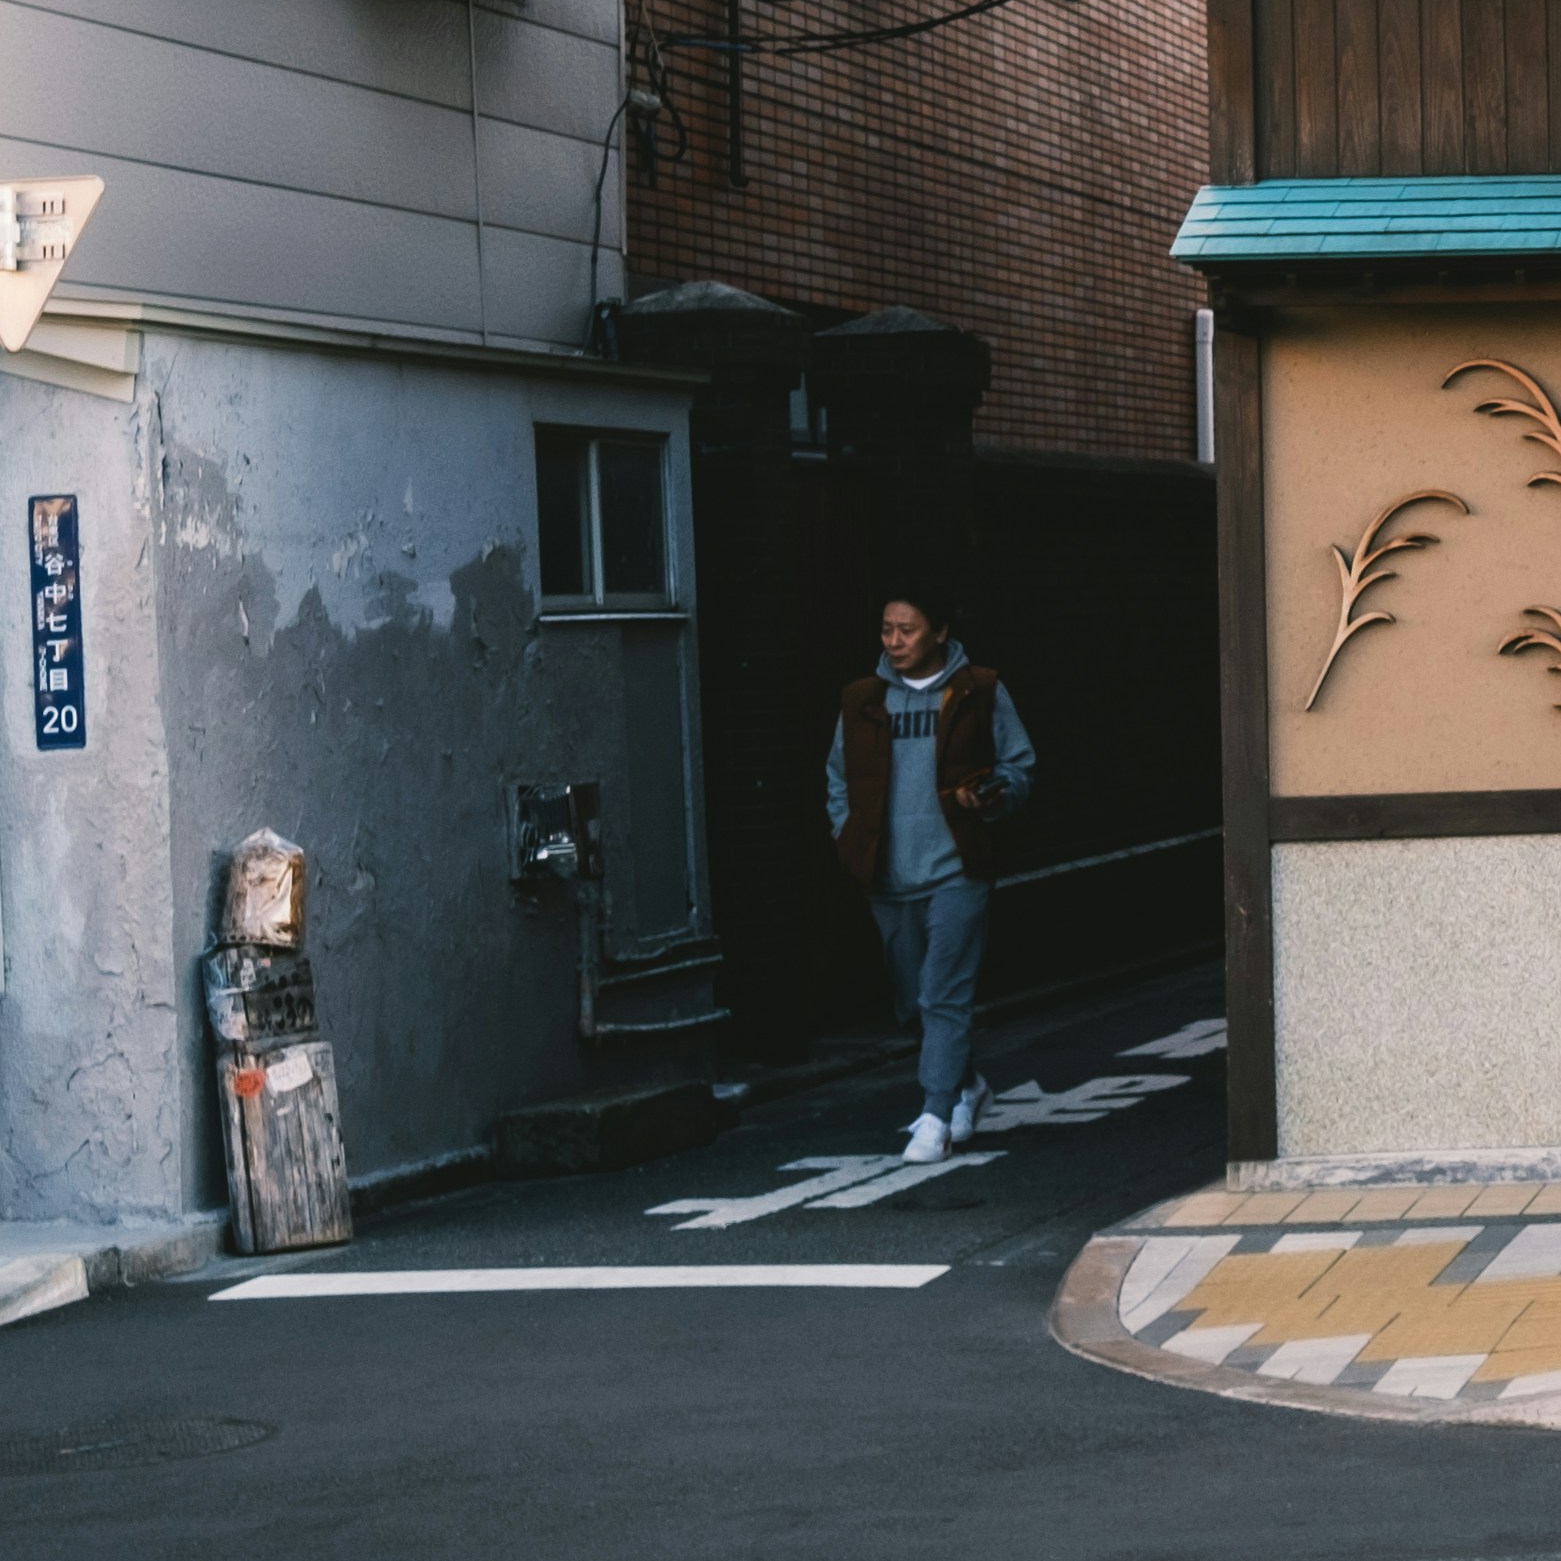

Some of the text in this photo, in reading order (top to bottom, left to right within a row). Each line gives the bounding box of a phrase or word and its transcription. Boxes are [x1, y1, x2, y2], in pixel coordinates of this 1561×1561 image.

[44, 552, 70, 692] 谷中七丁目
[43, 704, 78, 734] 20
